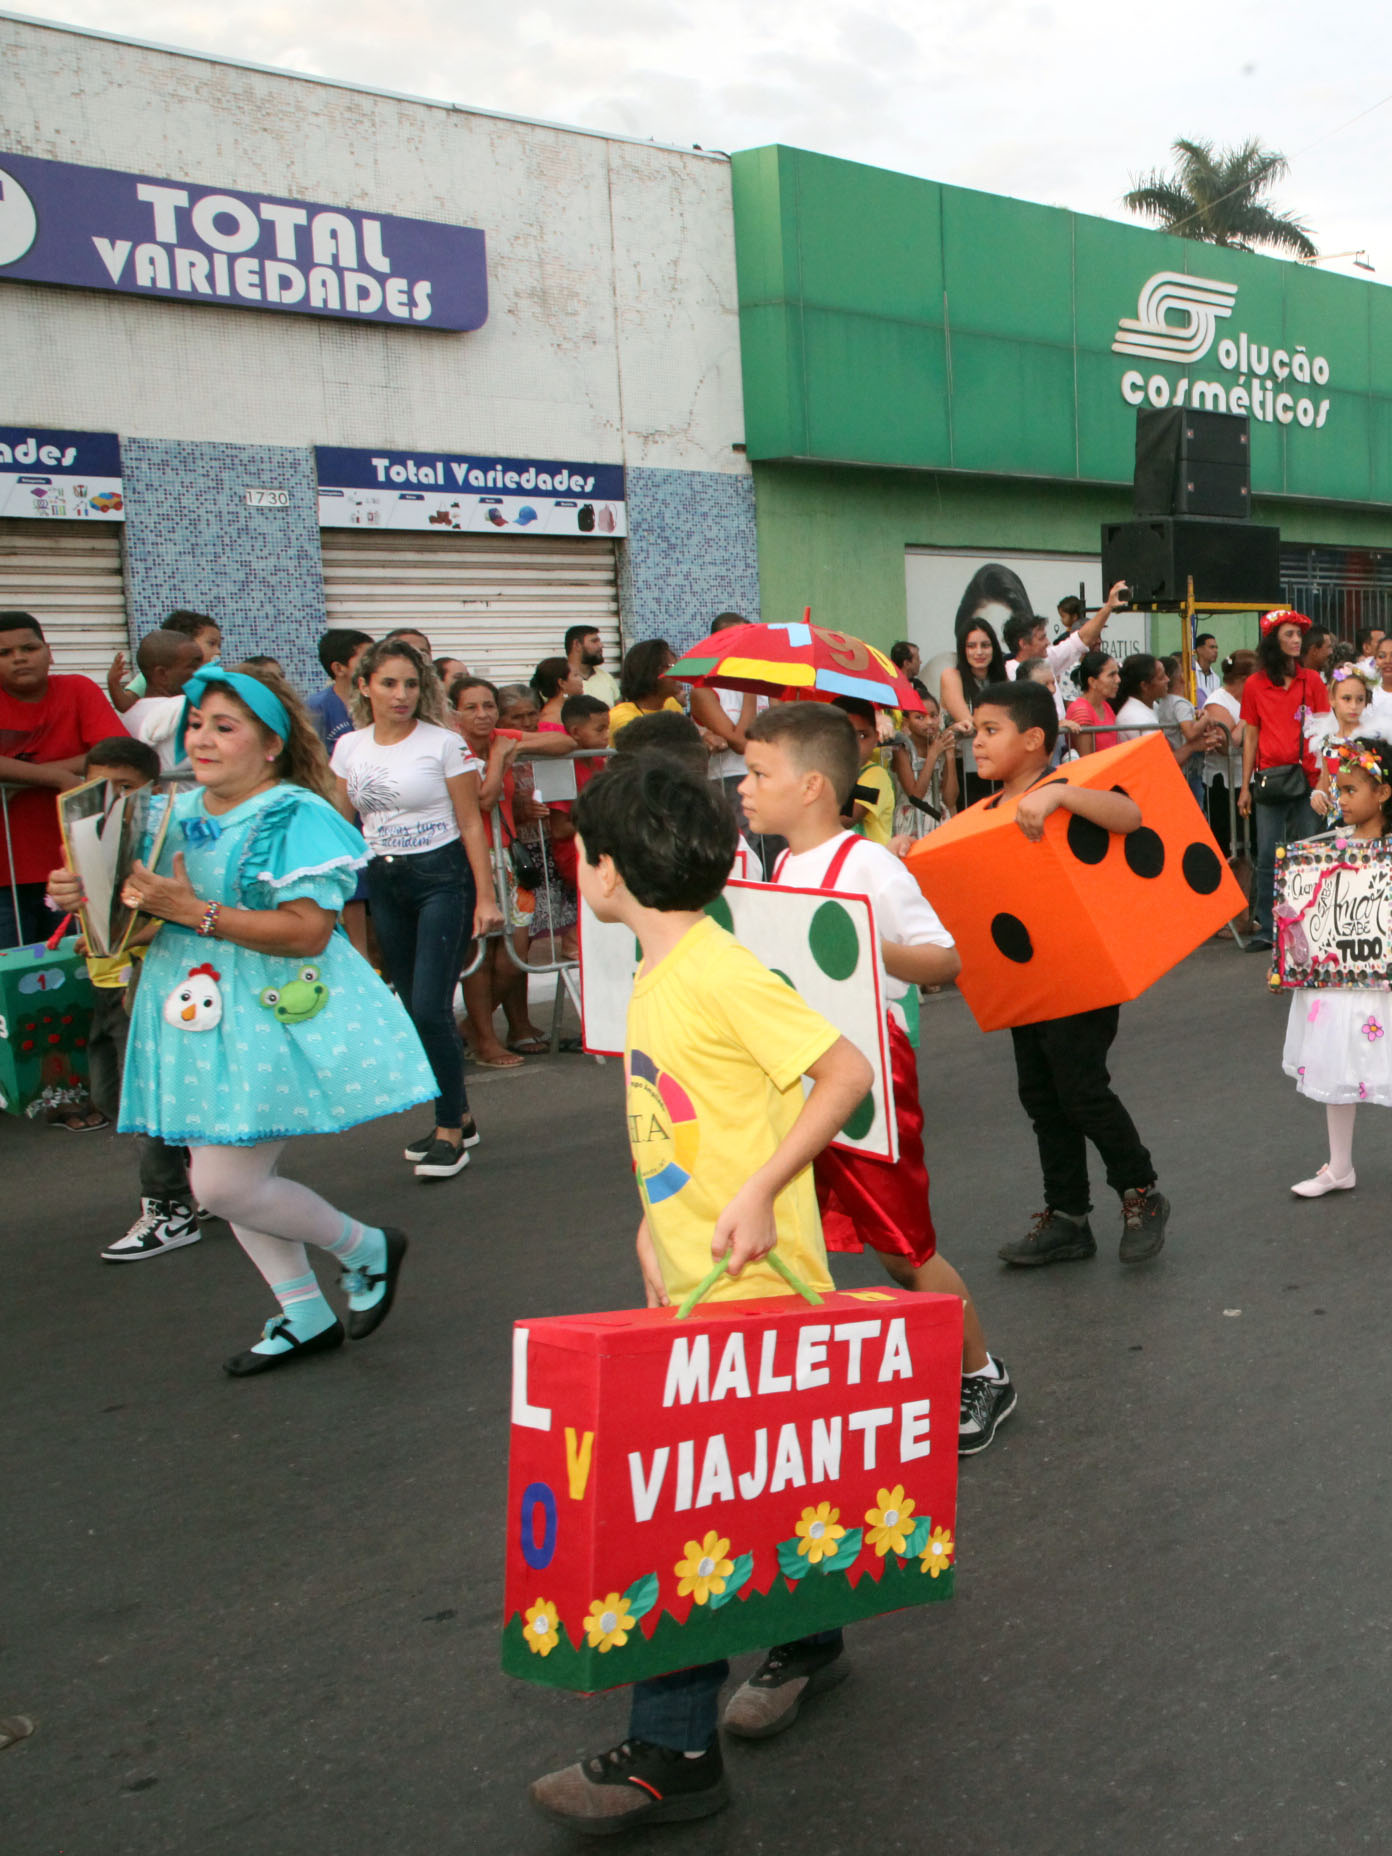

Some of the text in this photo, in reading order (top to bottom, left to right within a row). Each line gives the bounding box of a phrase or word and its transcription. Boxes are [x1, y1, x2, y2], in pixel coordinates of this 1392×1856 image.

[136, 182, 391, 274] TOTAL
[91, 235, 433, 321] VARIEDADES
[1120, 370, 1330, 429] cosméticos
[247, 490, 288, 505] 1730
[371, 457, 596, 493] Total Variedades
[1336, 936, 1383, 963] TUDO
[662, 1317, 914, 1408] MALETA
[626, 1399, 932, 1523] VIAJANTE
